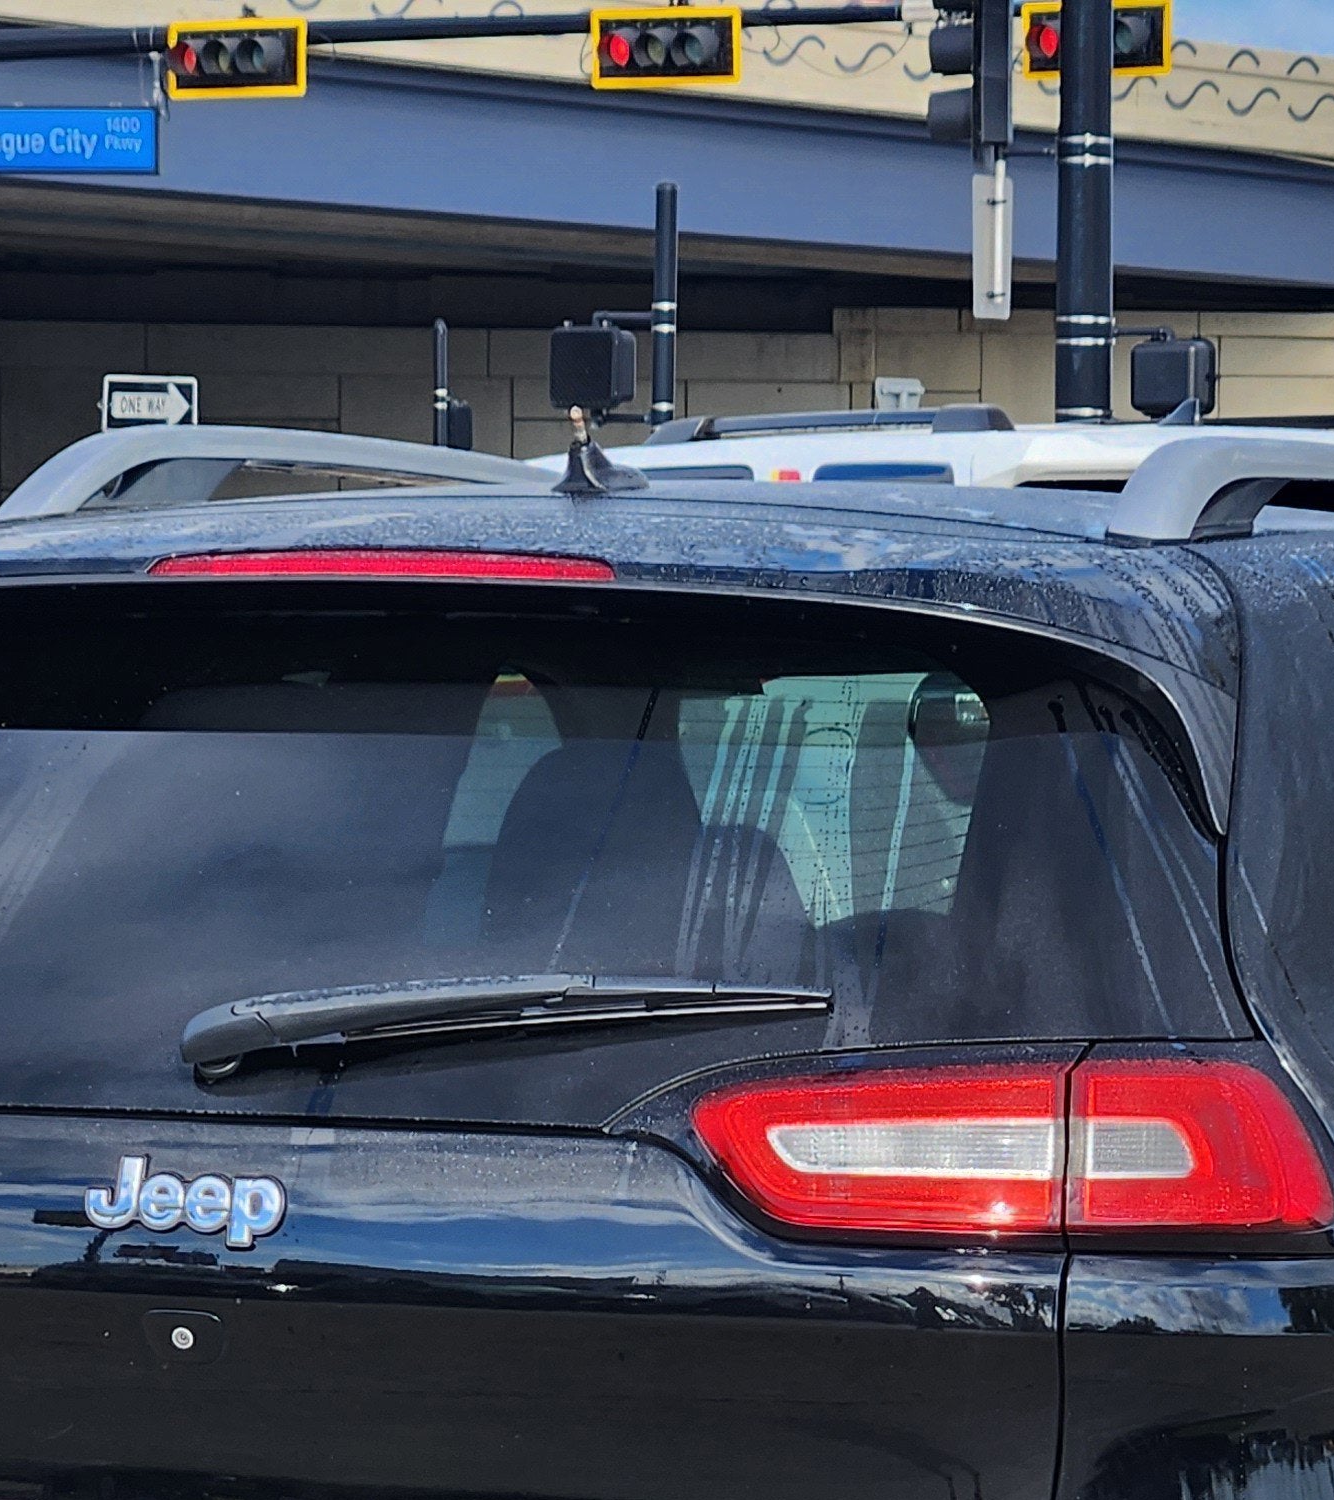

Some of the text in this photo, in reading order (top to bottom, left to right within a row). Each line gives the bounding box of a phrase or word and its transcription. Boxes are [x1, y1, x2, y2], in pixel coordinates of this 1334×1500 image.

[49, 127, 98, 159] City
[120, 396, 166, 413] ONE WAY
[85, 1154, 288, 1251] Jeep
